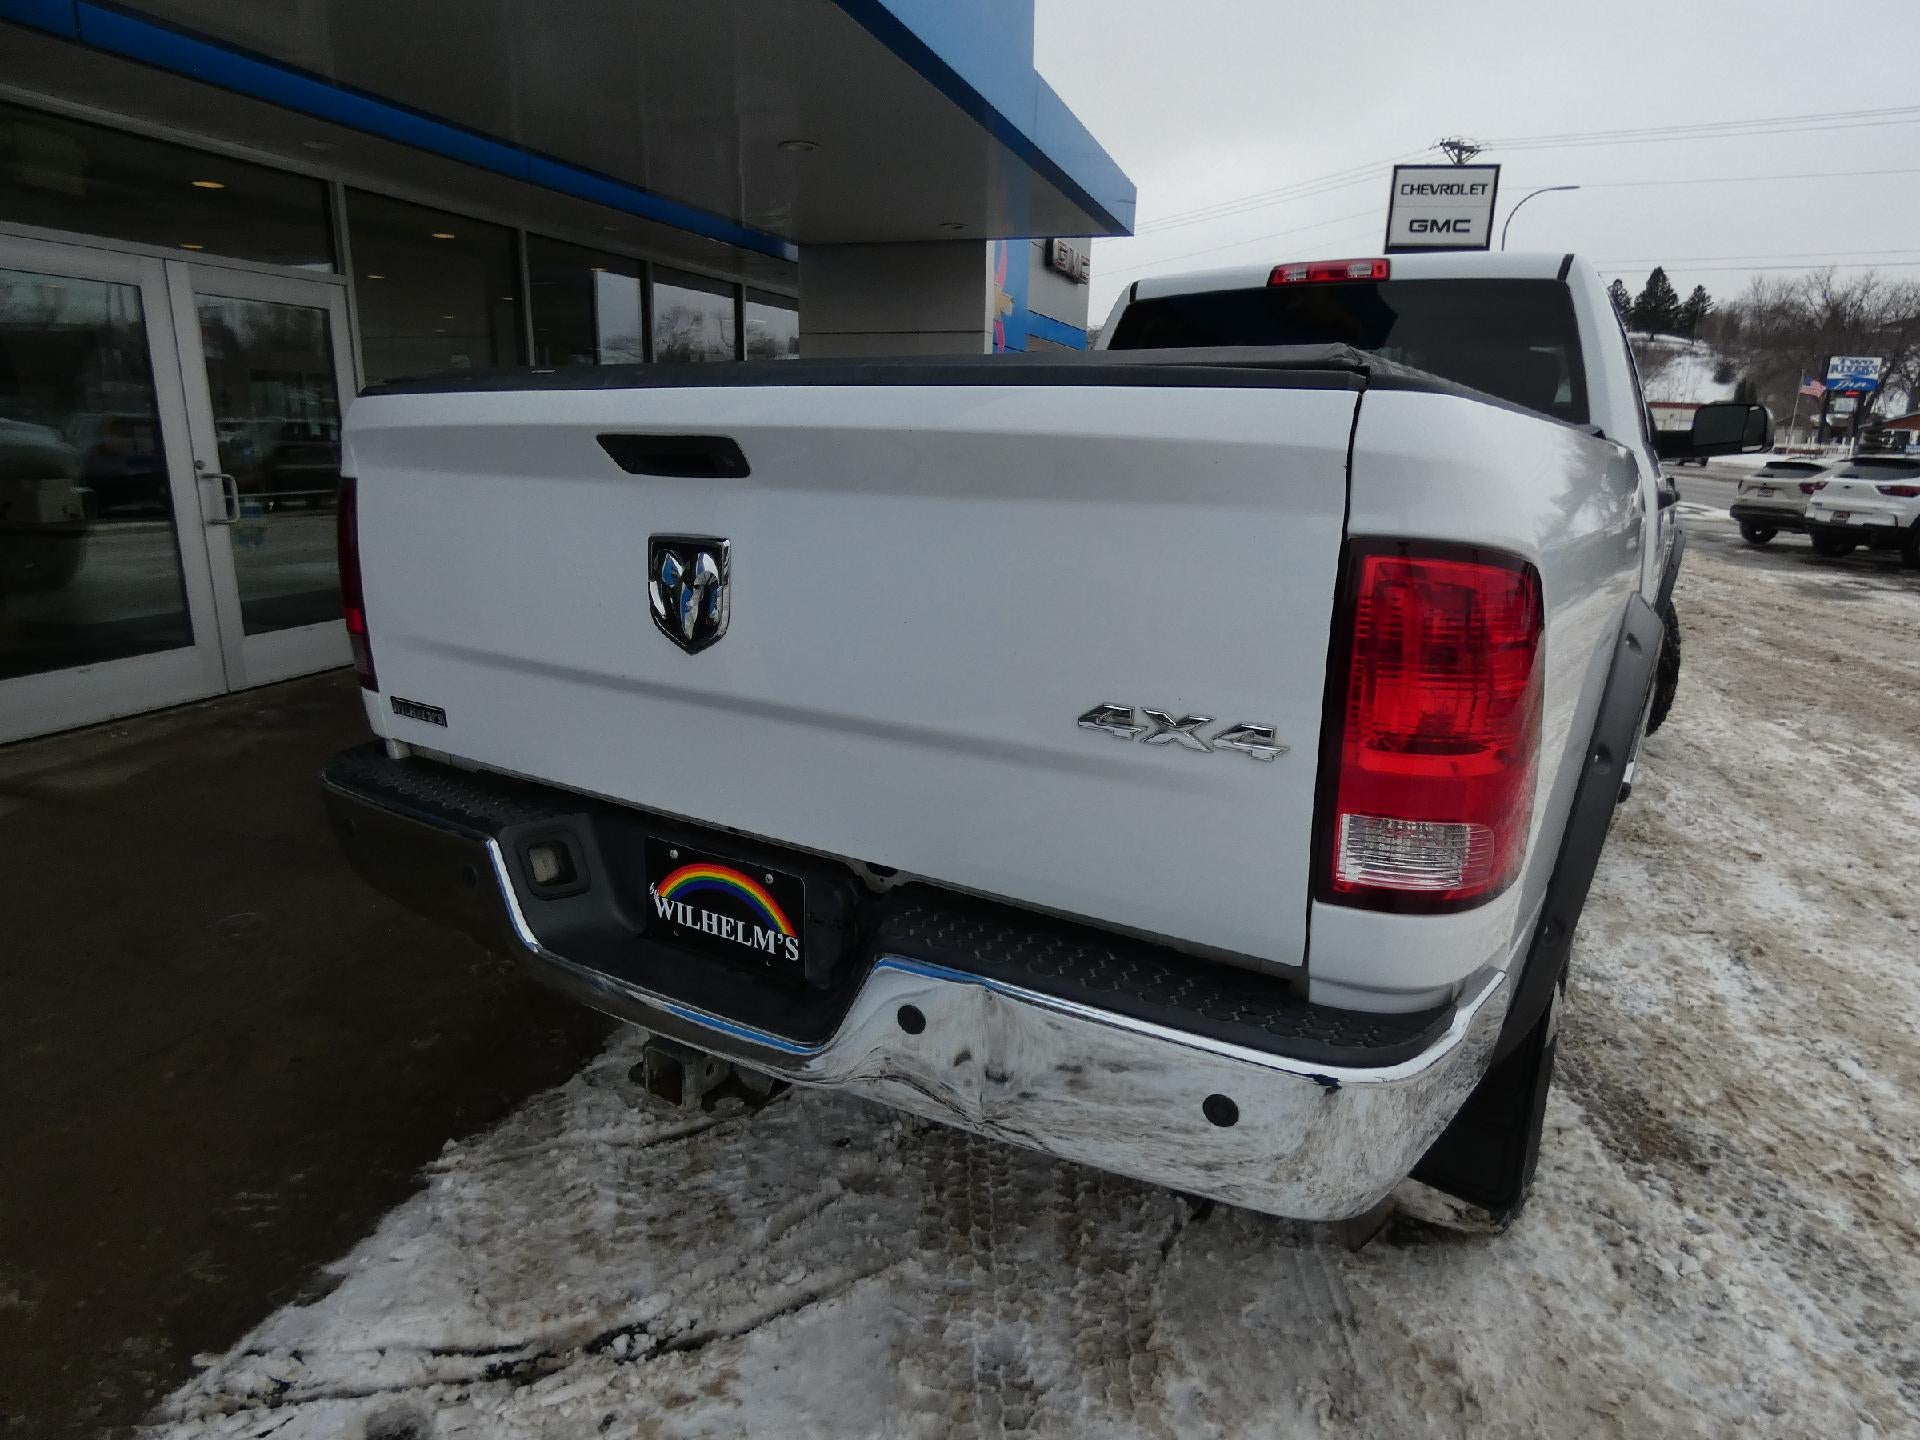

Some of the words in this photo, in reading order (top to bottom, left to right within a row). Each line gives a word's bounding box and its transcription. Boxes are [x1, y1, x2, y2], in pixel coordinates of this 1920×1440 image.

[1400, 183, 1488, 196] CHEVROLET
[1408, 219, 1471, 233] GMC
[654, 896, 799, 961] WILHELM'S
